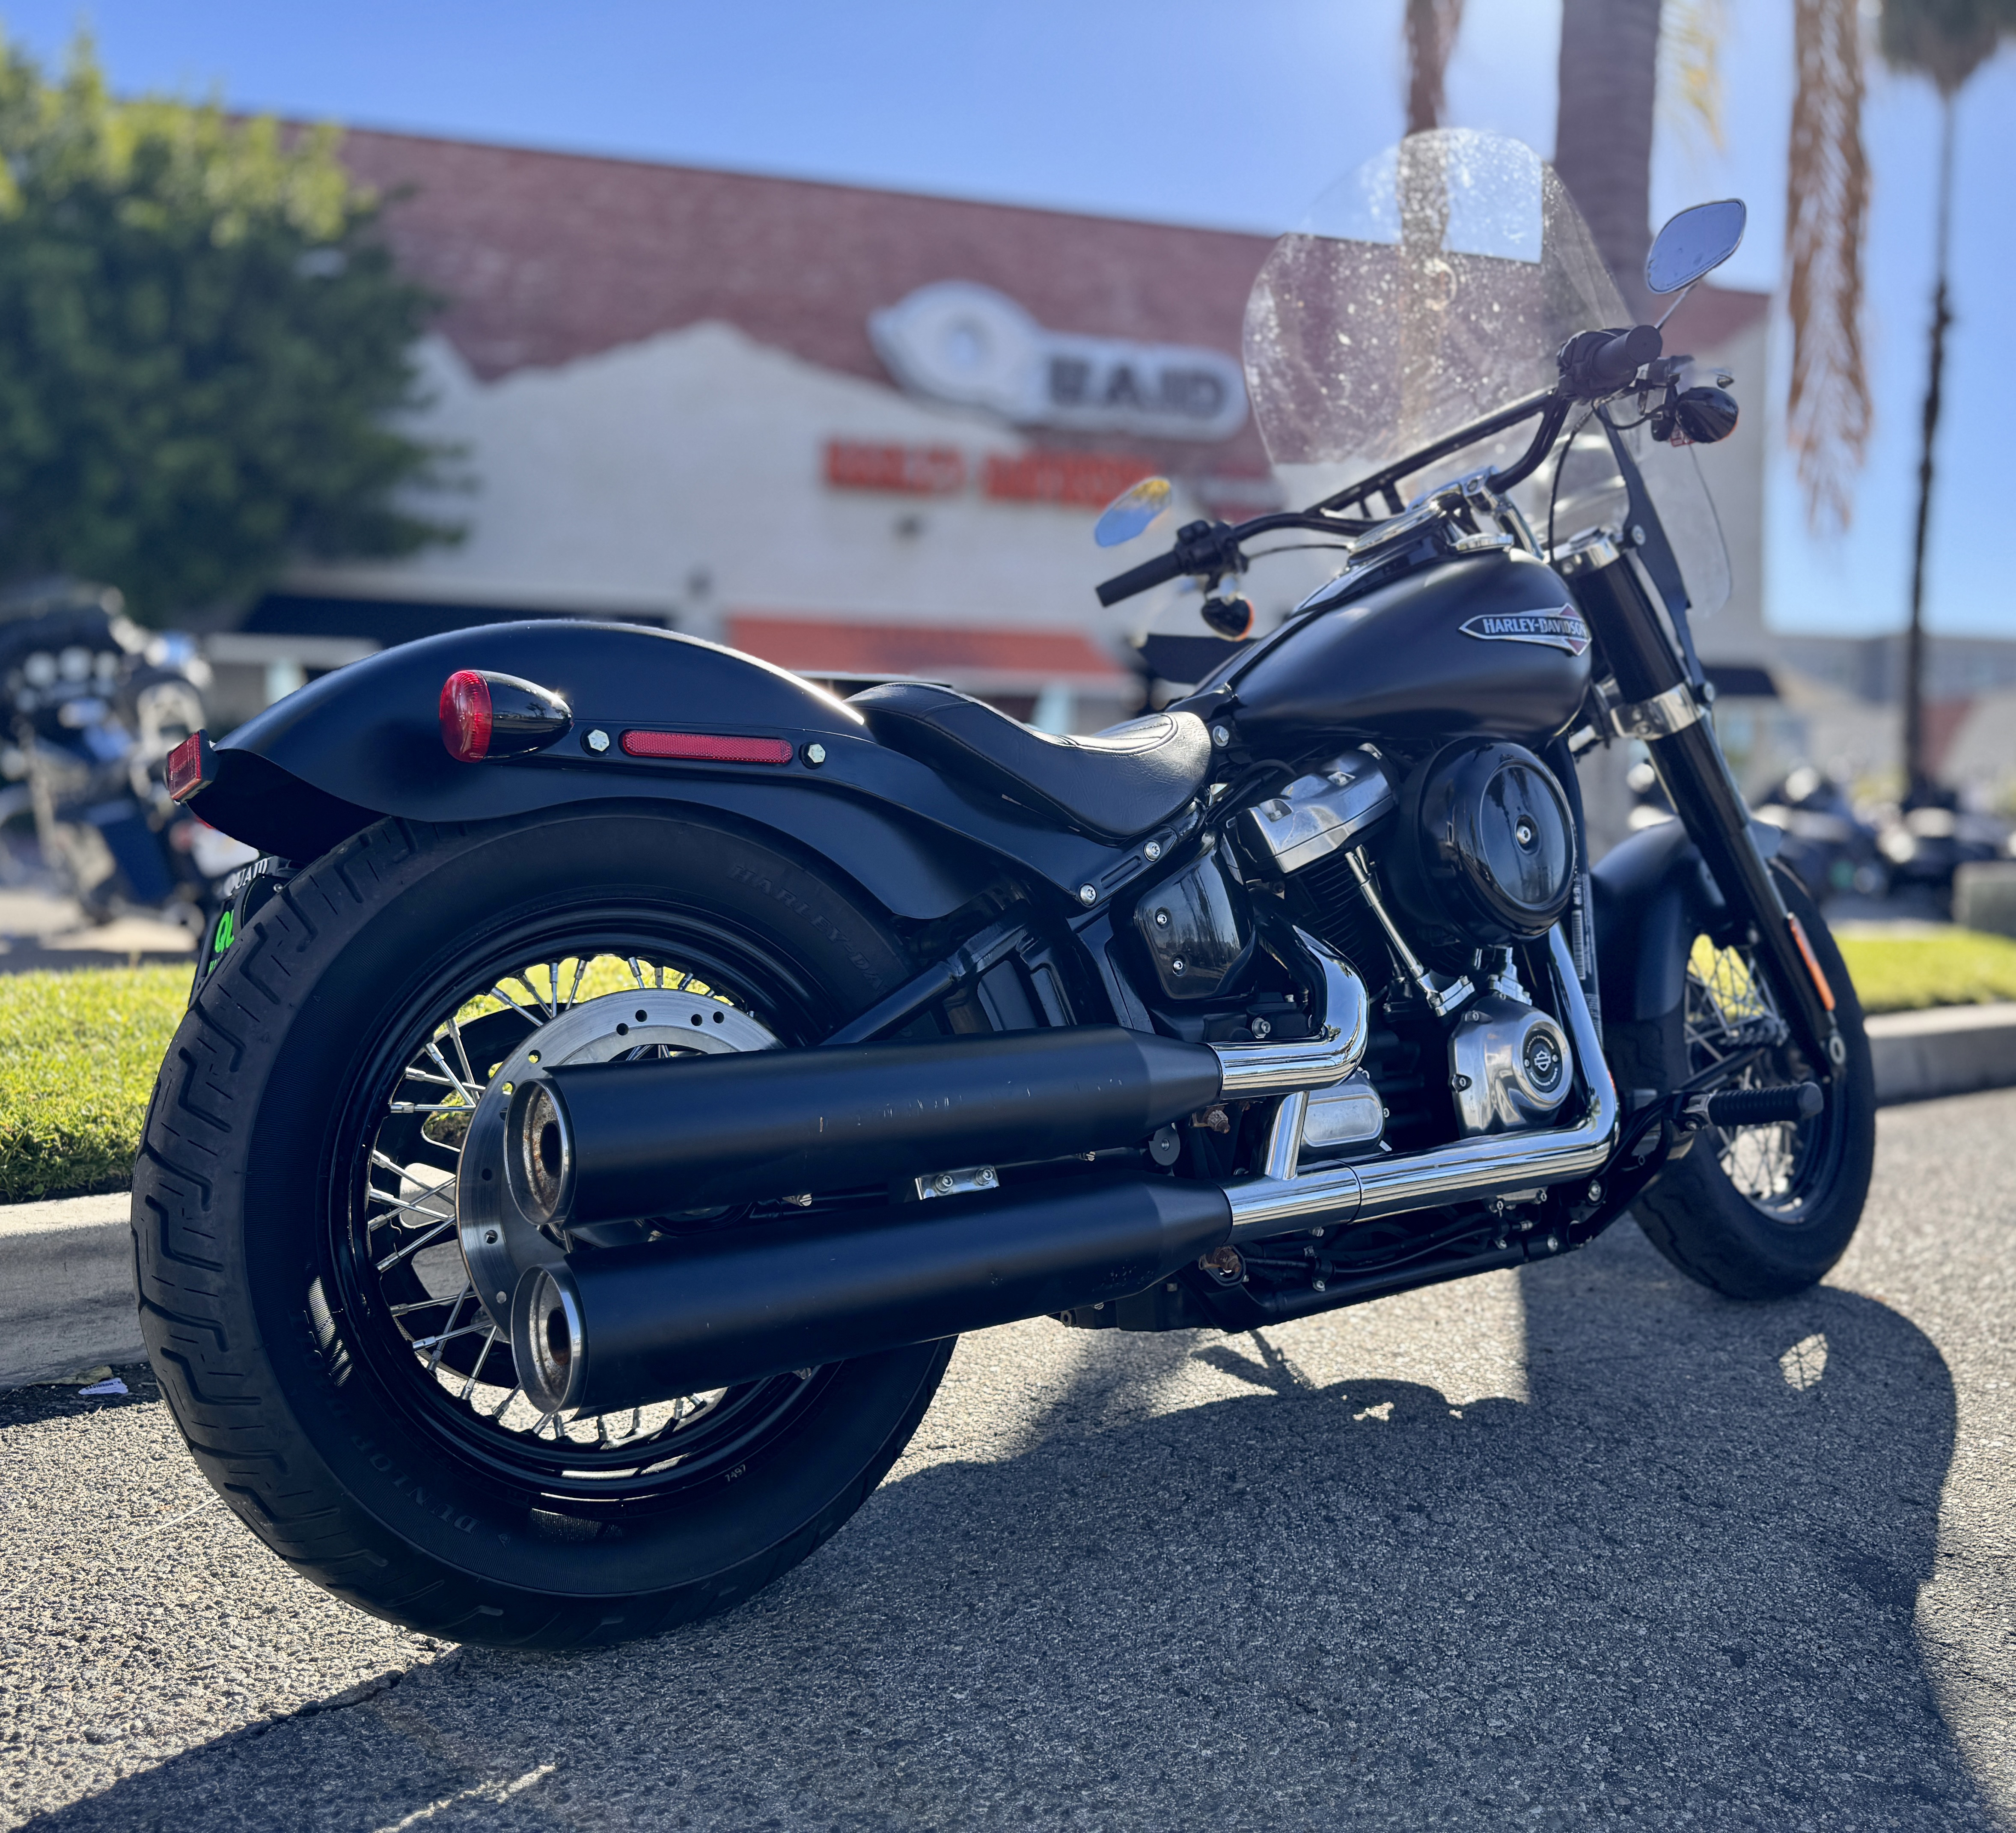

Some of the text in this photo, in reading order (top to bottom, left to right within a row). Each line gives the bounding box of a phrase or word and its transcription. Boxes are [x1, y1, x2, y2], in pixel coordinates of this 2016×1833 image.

[1483, 618, 1587, 637] HARLEY-DAVIDSON
[726, 864, 889, 994] HARLEY-DA
[351, 1435, 483, 1535] DUNLOP
